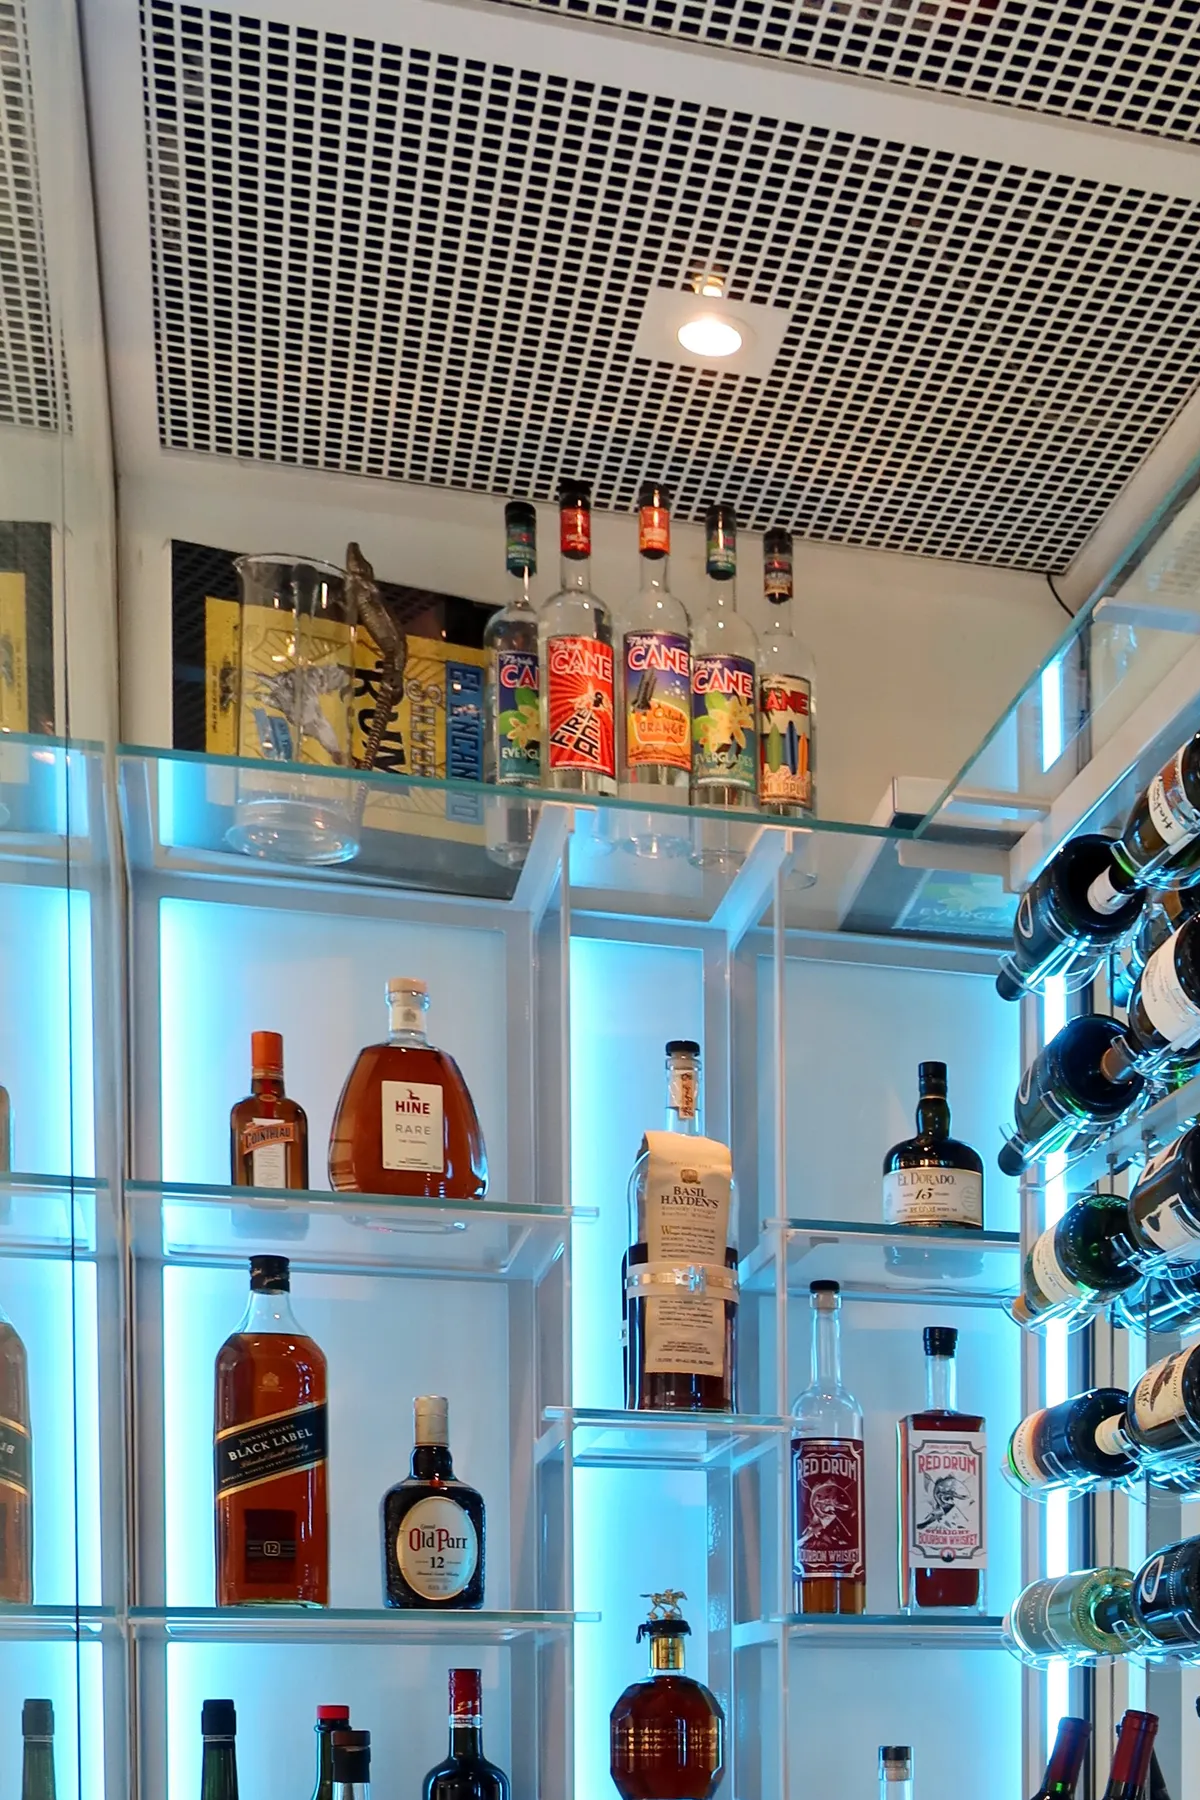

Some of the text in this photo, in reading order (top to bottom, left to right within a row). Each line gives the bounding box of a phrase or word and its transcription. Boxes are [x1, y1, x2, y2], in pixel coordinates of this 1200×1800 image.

[551, 650, 612, 683] CANE
[628, 645, 689, 677] CANE
[693, 670, 753, 698] CANE
[760, 688, 808, 716] ANE
[551, 704, 586, 747] FIRE
[639, 720, 686, 736] ORANGE
[573, 711, 600, 761] ANT
[395, 1100, 431, 1115] HINE
[395, 1124, 431, 1135] RARE
[911, 1172, 955, 1186] DORADO
[673, 1186, 707, 1198] BASIL
[916, 1188, 934, 1200] 15
[661, 1195, 719, 1210] HAYDEN'S
[228, 1440, 270, 1461] BLACK
[273, 1428, 313, 1447] LABEL
[797, 1458, 857, 1482] RED DRUM
[918, 1456, 977, 1476] RED DRUM
[266, 1543, 278, 1554] 12
[409, 1528, 468, 1552] Old Parr
[919, 1534, 978, 1546] BOURBON WHISKEY
[430, 1556, 445, 1568] 12
